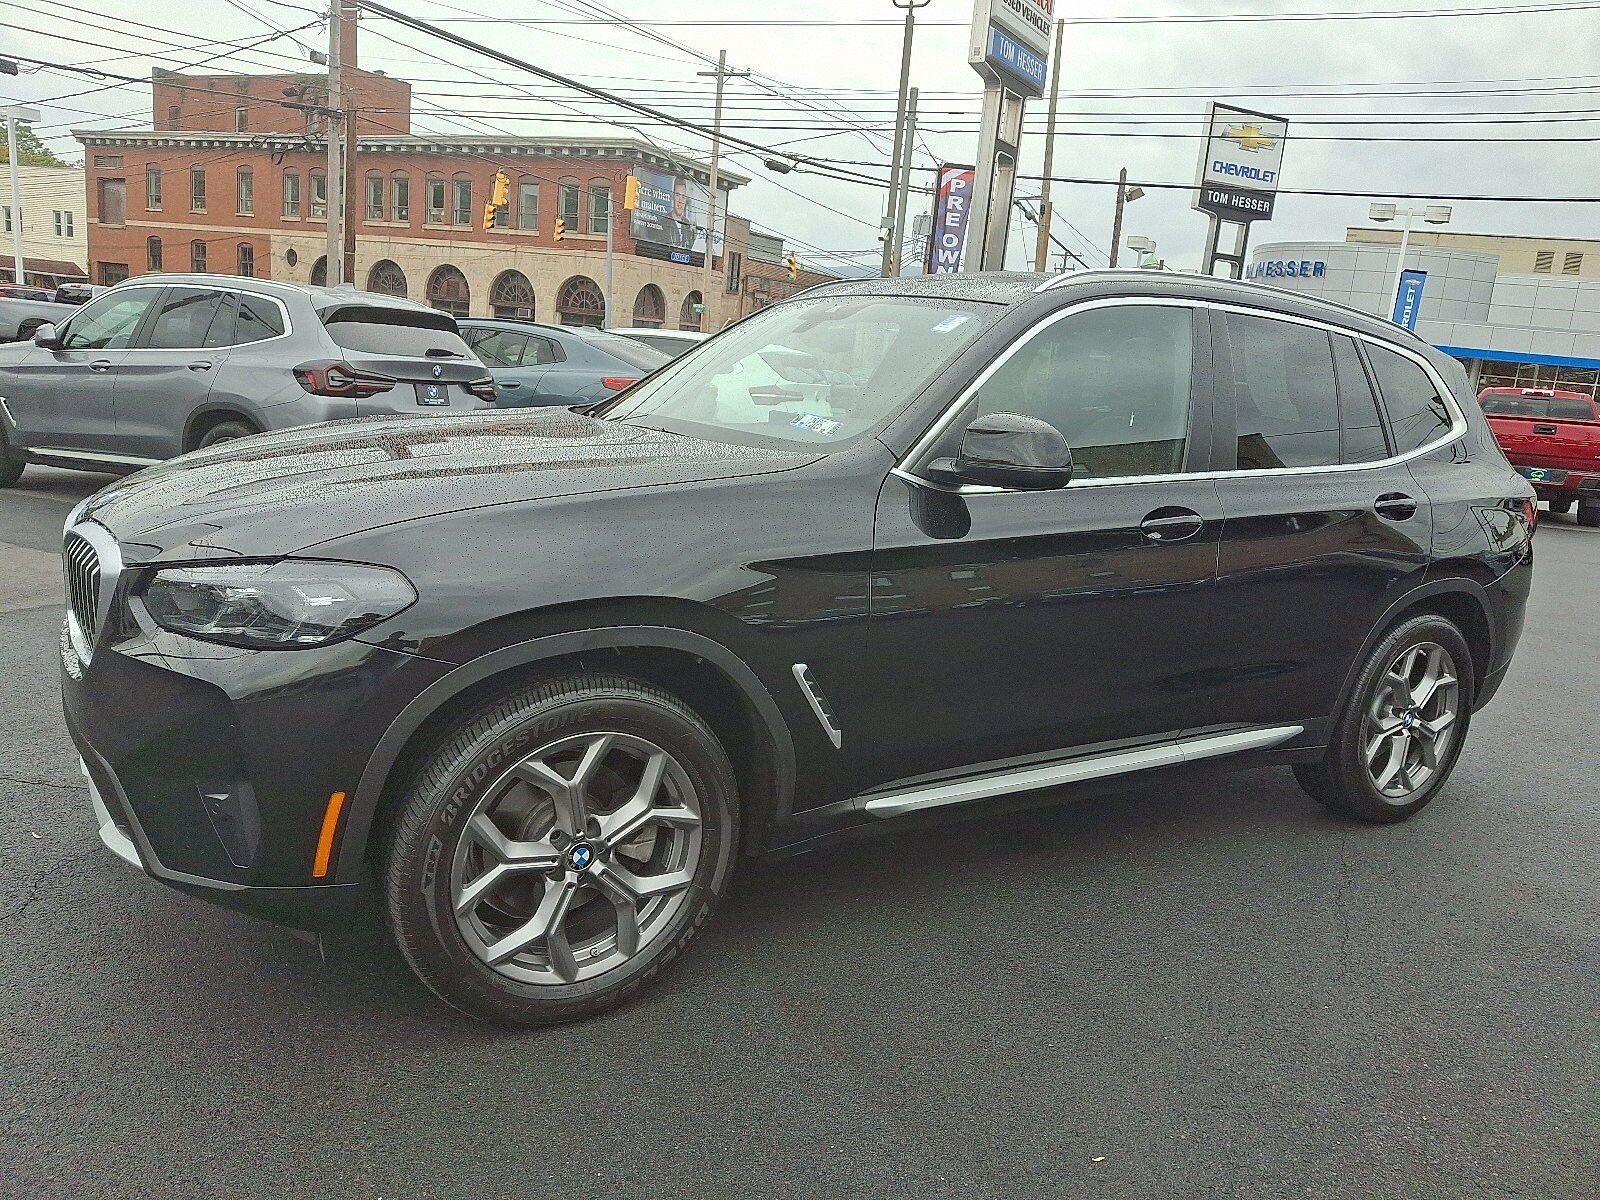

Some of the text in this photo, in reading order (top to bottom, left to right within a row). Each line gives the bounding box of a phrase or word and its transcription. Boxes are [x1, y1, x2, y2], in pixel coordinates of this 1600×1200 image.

[1022, 3, 1051, 37] VEHICLES
[1000, 36, 1043, 80] TOM HESSER
[1212, 160, 1276, 184] CHEVROLET
[653, 188, 670, 201] when
[945, 178, 966, 227] PRE
[1207, 190, 1271, 213] TOM HESSER
[641, 200, 667, 213] matters.
[1257, 260, 1325, 278] HESSER
